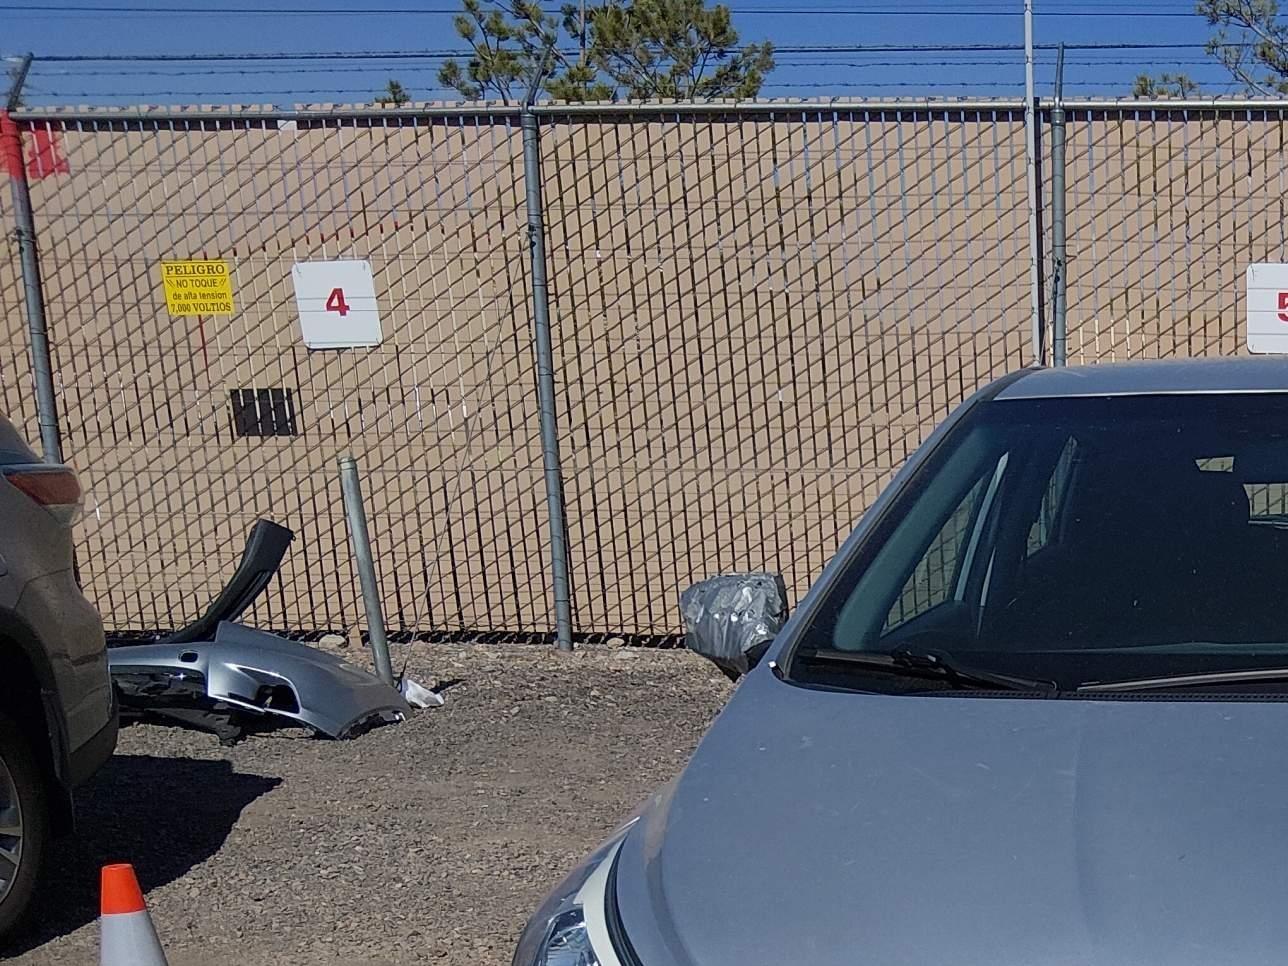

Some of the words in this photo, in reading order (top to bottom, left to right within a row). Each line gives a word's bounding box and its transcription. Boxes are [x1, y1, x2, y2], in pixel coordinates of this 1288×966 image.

[165, 264, 225, 275] PELIGRO
[176, 279, 188, 288] NO
[189, 278, 219, 288] TOQUE
[172, 291, 182, 300] de
[192, 302, 231, 312] VOLTIOS
[326, 287, 350, 317] 4
